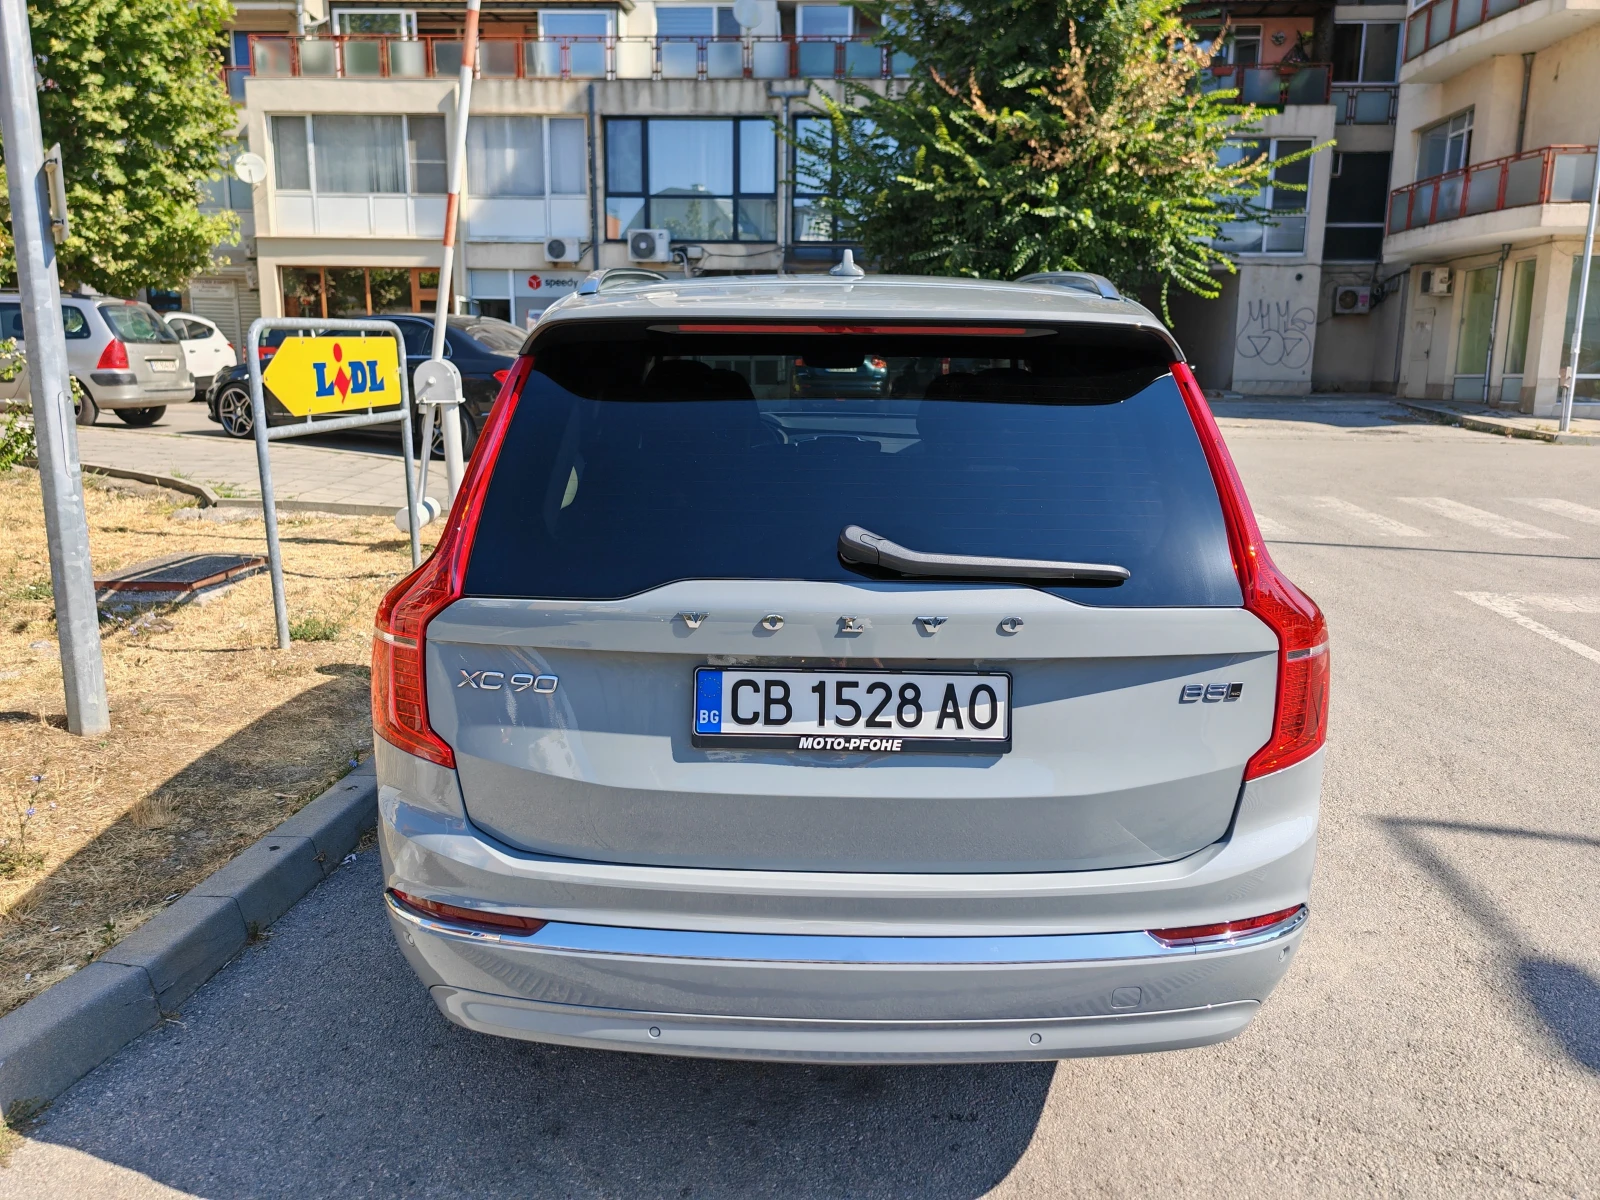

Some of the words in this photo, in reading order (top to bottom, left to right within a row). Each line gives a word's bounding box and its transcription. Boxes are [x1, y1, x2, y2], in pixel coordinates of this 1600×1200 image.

[545, 278, 579, 289] speedy
[678, 610, 1025, 634] VOLVO
[731, 678, 793, 726] CB
[811, 680, 923, 729] 1528
[935, 683, 998, 730] AO
[699, 709, 720, 724] BG
[798, 736, 903, 752] MOTO-PFOHE
